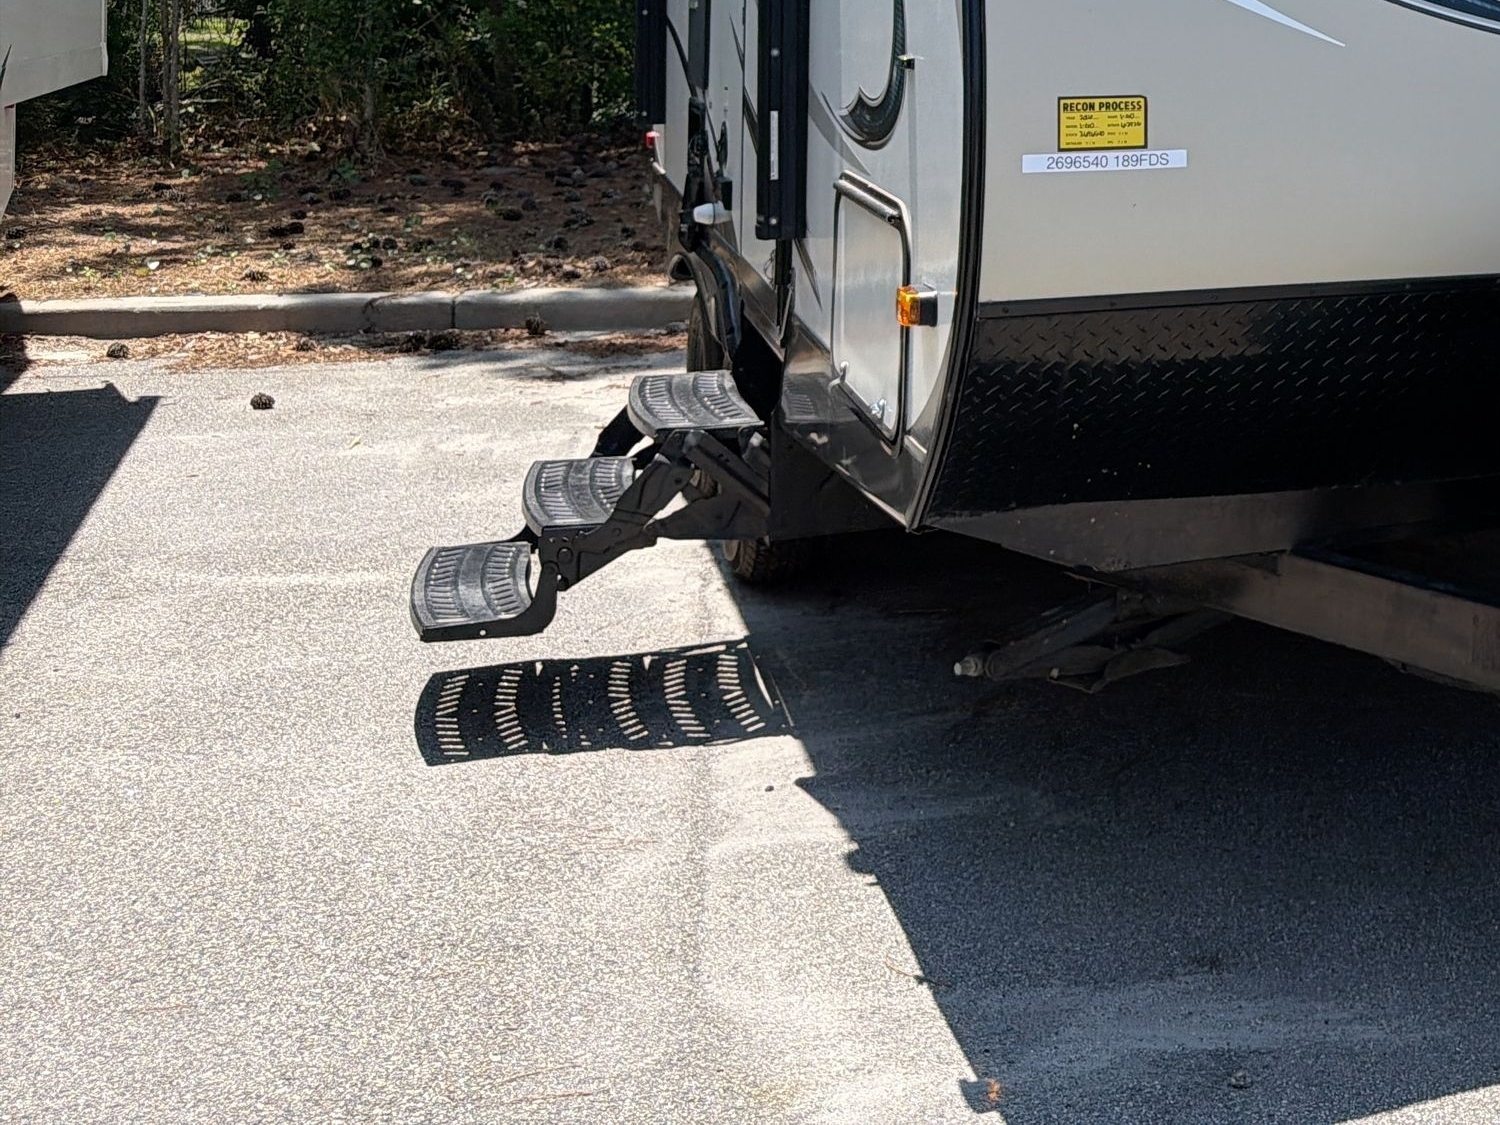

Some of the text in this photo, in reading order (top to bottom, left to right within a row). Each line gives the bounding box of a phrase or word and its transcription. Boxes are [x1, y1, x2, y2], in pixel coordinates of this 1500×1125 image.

[1062, 100, 1142, 112] RECON PROCESS
[1046, 153, 1170, 170] 2696540 189FDS
